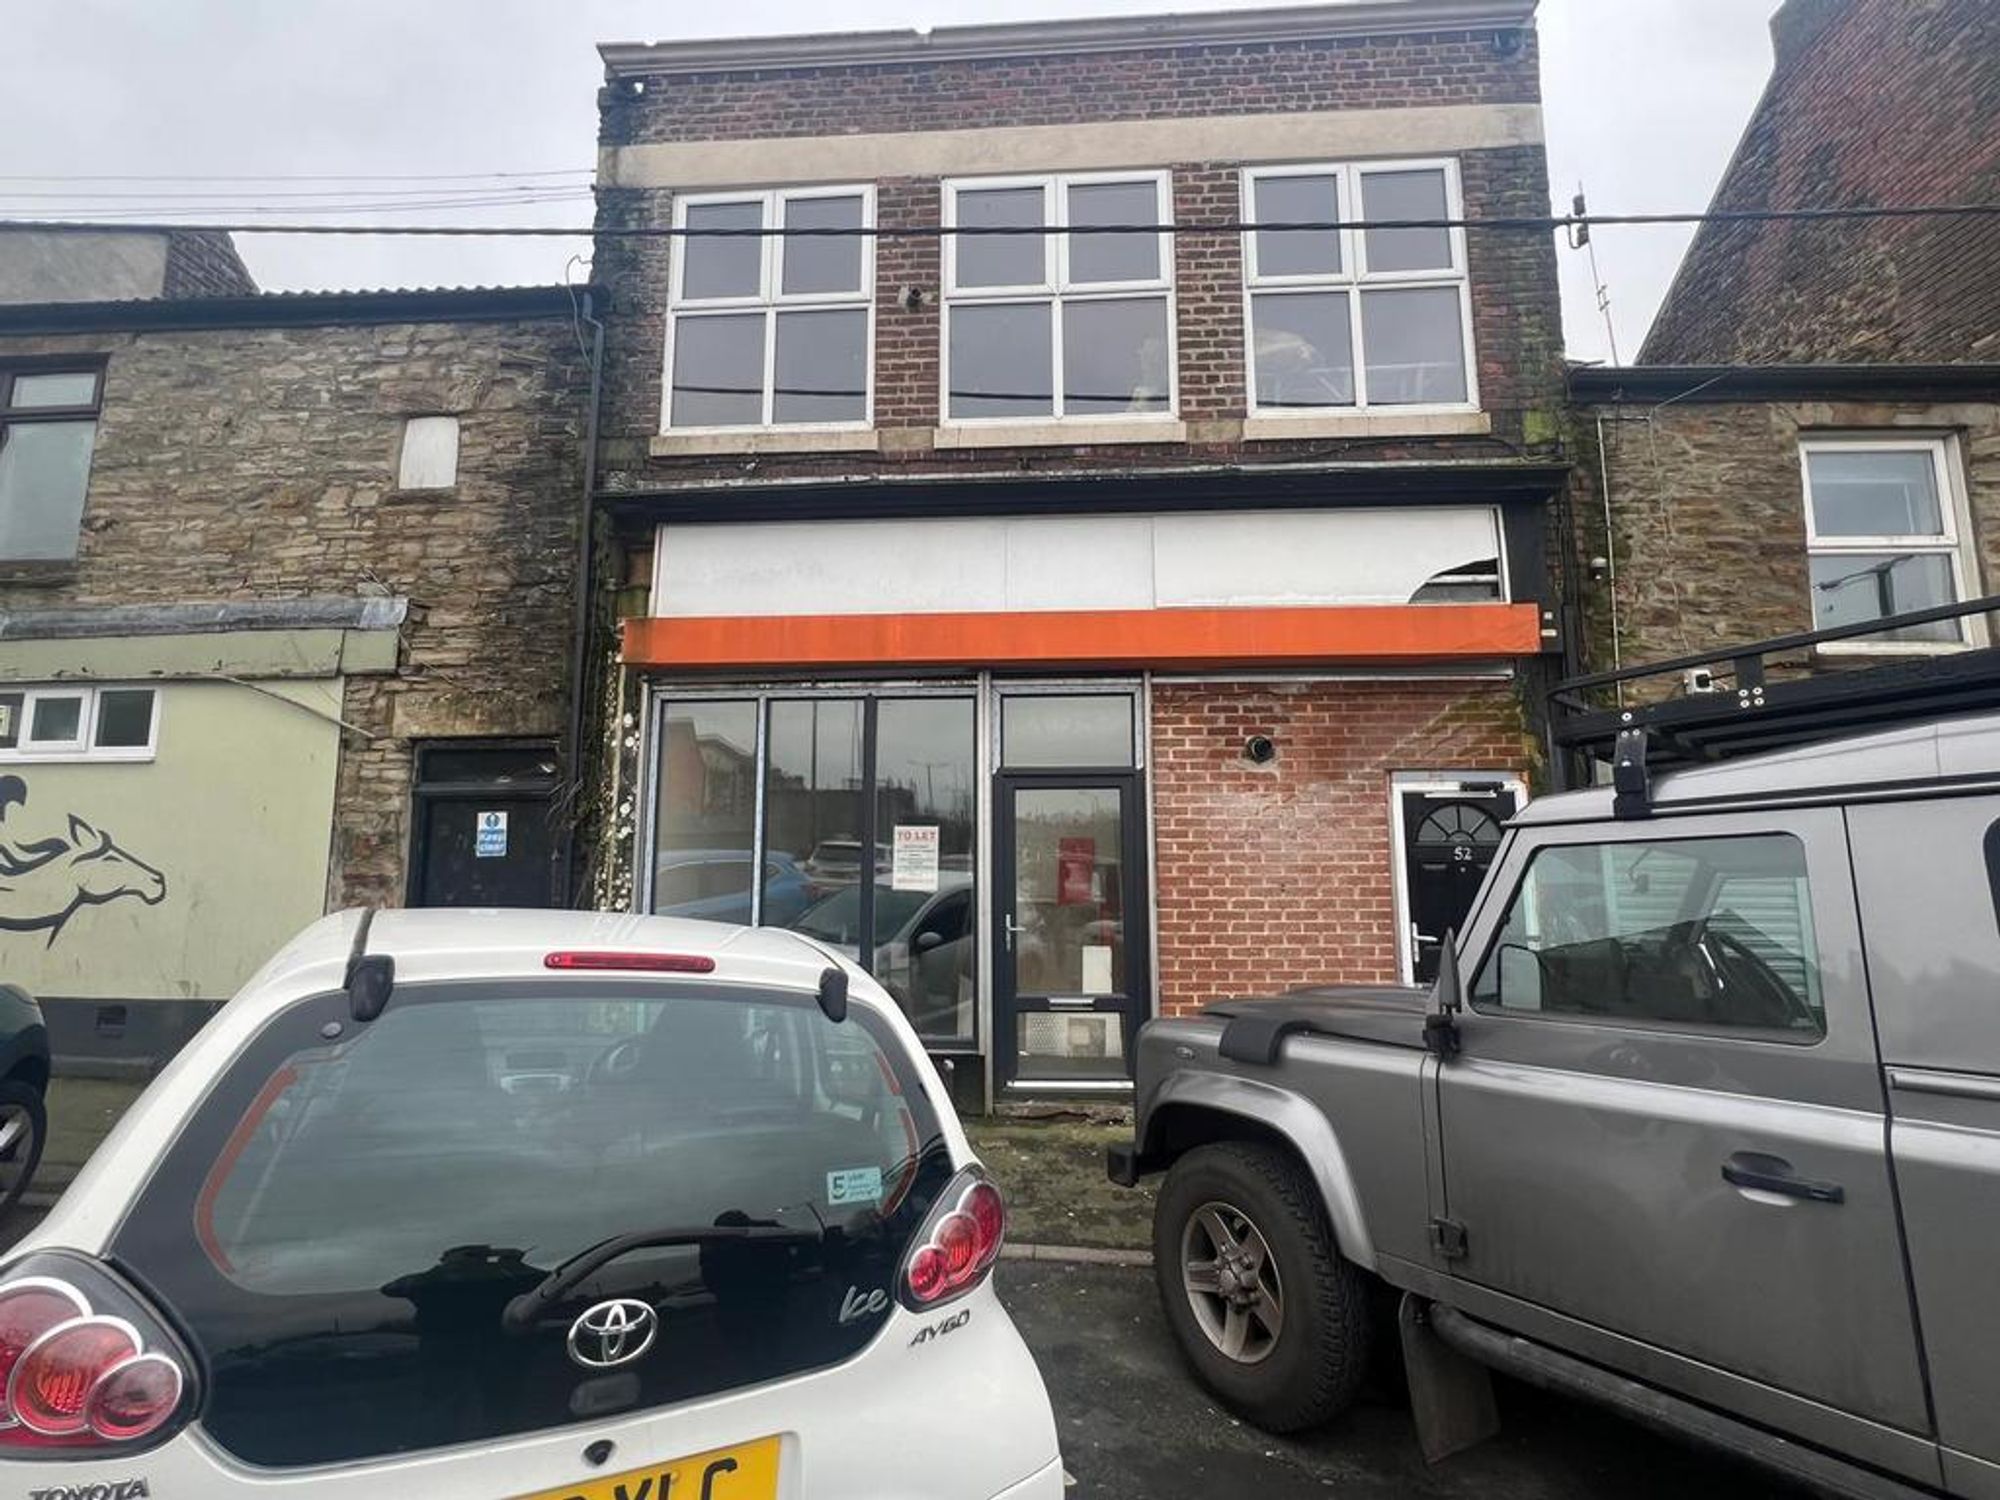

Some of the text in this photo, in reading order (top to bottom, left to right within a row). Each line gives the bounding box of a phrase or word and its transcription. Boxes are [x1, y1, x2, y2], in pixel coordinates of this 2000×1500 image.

[897, 831, 937, 842] TO LET
[1454, 846, 1472, 861] 52
[832, 1175, 847, 1200] 5
[839, 1285, 888, 1322] Ice
[908, 1308, 970, 1347] AYGO
